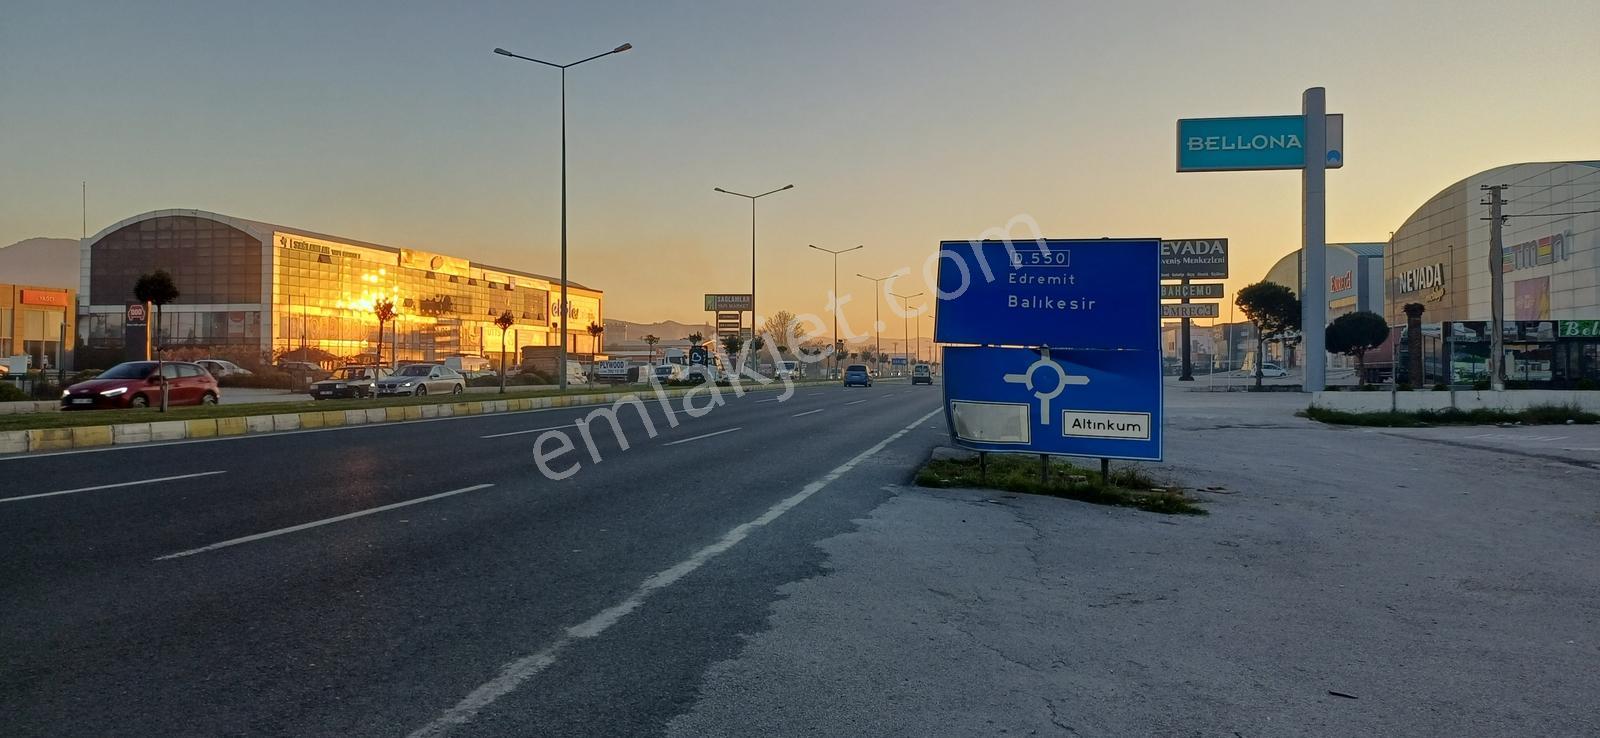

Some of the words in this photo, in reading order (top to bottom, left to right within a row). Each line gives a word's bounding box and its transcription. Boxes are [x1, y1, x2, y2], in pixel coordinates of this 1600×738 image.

[1187, 134, 1302, 151] BELLONA
[1160, 240, 1224, 255] EVADA
[1014, 252, 1065, 265] D.550
[1009, 273, 1075, 285] Edremit
[1399, 263, 1443, 294] NEVADA
[1008, 295, 1096, 311] Balıkesir
[1566, 321, 1600, 336] Bel
[1072, 418, 1142, 432] Altınkum
